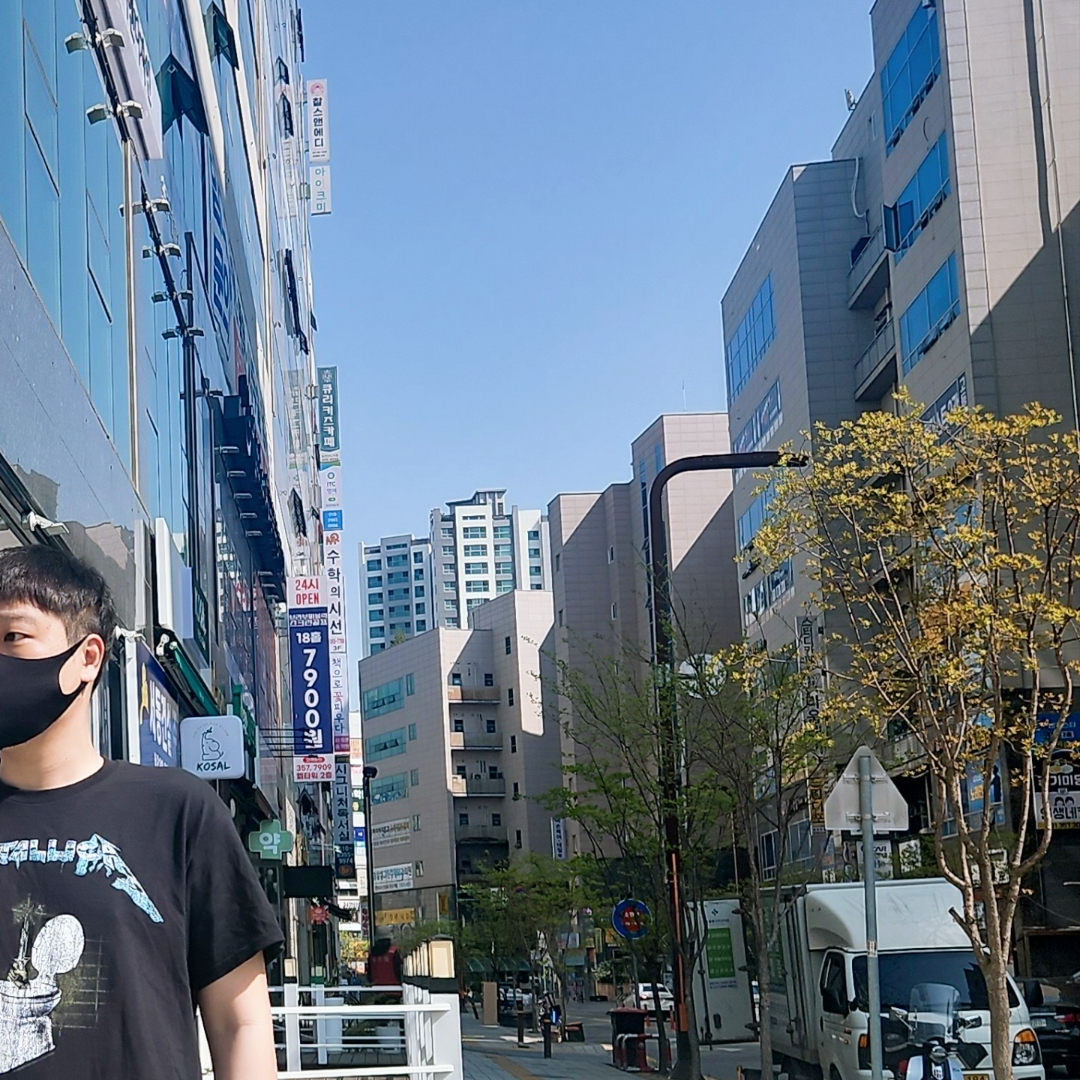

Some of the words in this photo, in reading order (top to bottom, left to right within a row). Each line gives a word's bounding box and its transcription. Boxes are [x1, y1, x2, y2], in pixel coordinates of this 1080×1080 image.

[321, 383, 335, 448] 큐리키즈카페
[295, 578, 319, 591] 24시
[295, 593, 320, 605] OPEN
[296, 631, 322, 644] 18홀
[196, 761, 231, 772] KOSAL
[335, 763, 350, 842] 시그니처독서실
[259, 832, 281, 855] 약
